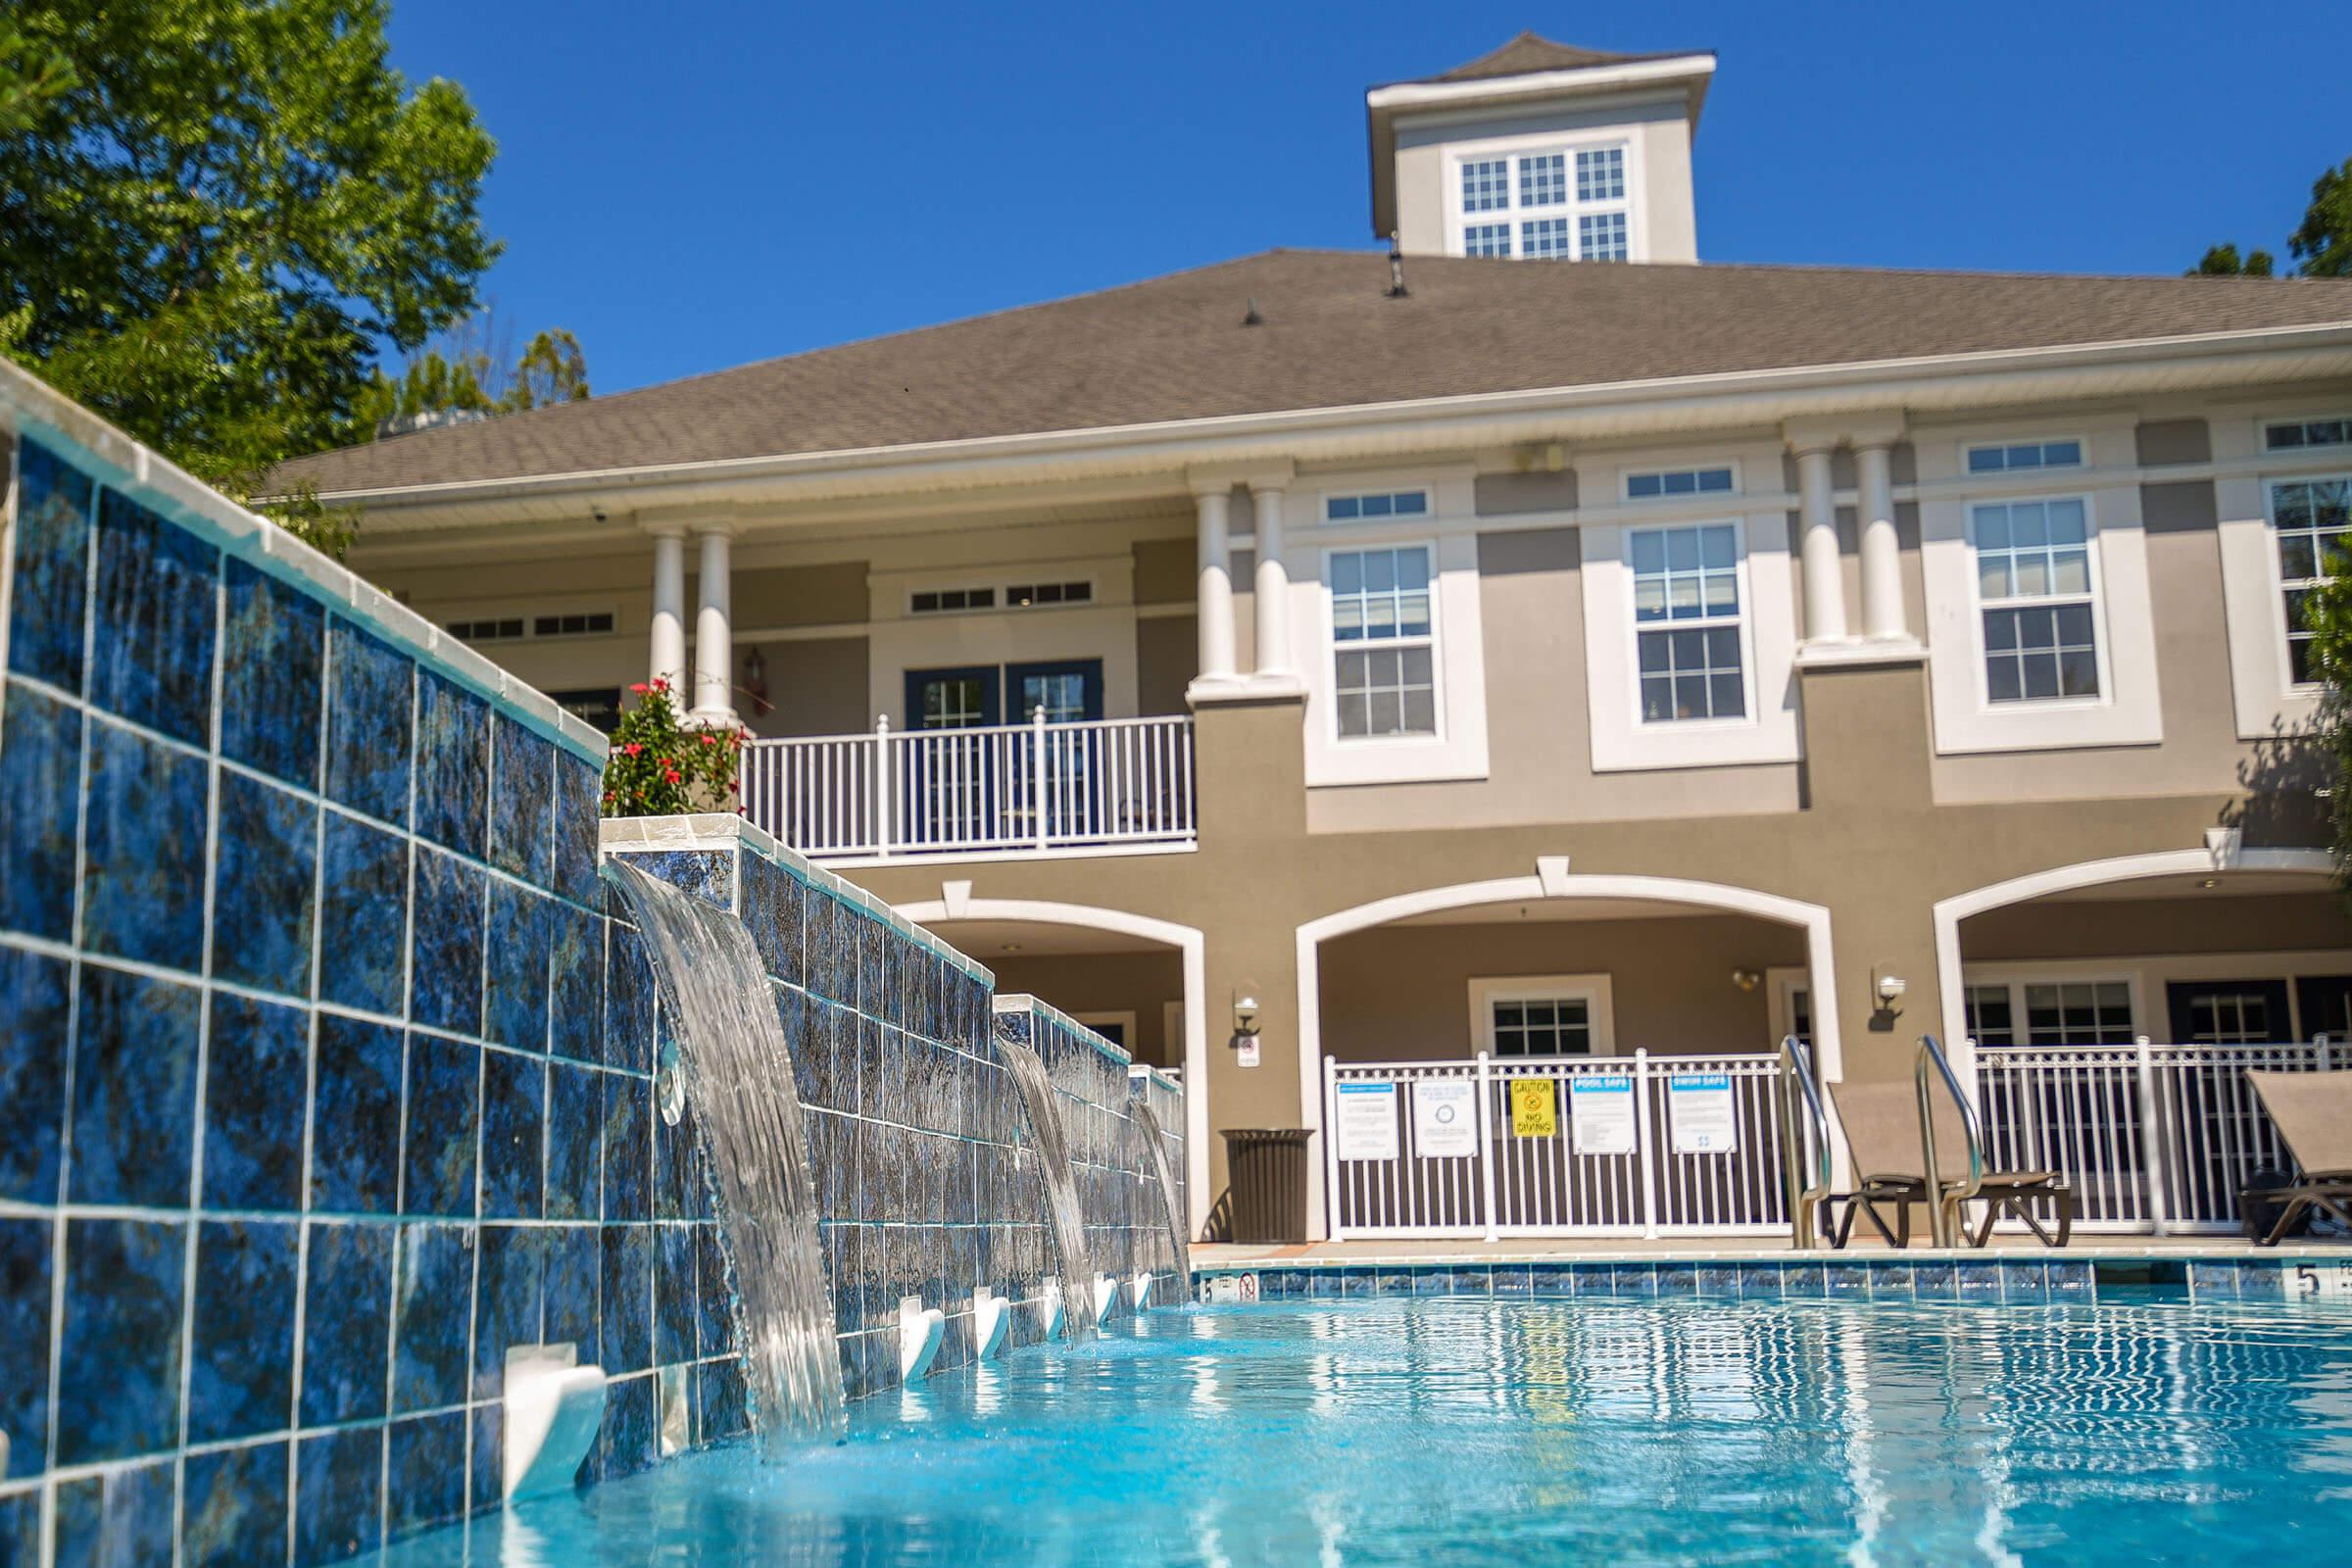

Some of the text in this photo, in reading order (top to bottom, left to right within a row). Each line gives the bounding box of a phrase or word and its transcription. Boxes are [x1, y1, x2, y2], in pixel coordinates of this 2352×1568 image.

[1575, 1078, 1601, 1089] POOL
[1526, 1112, 1542, 1122] NO
[1517, 1121, 1552, 1133] DIVING
[2297, 1263, 2320, 1299] 5
[1204, 1278, 1213, 1302] 5
